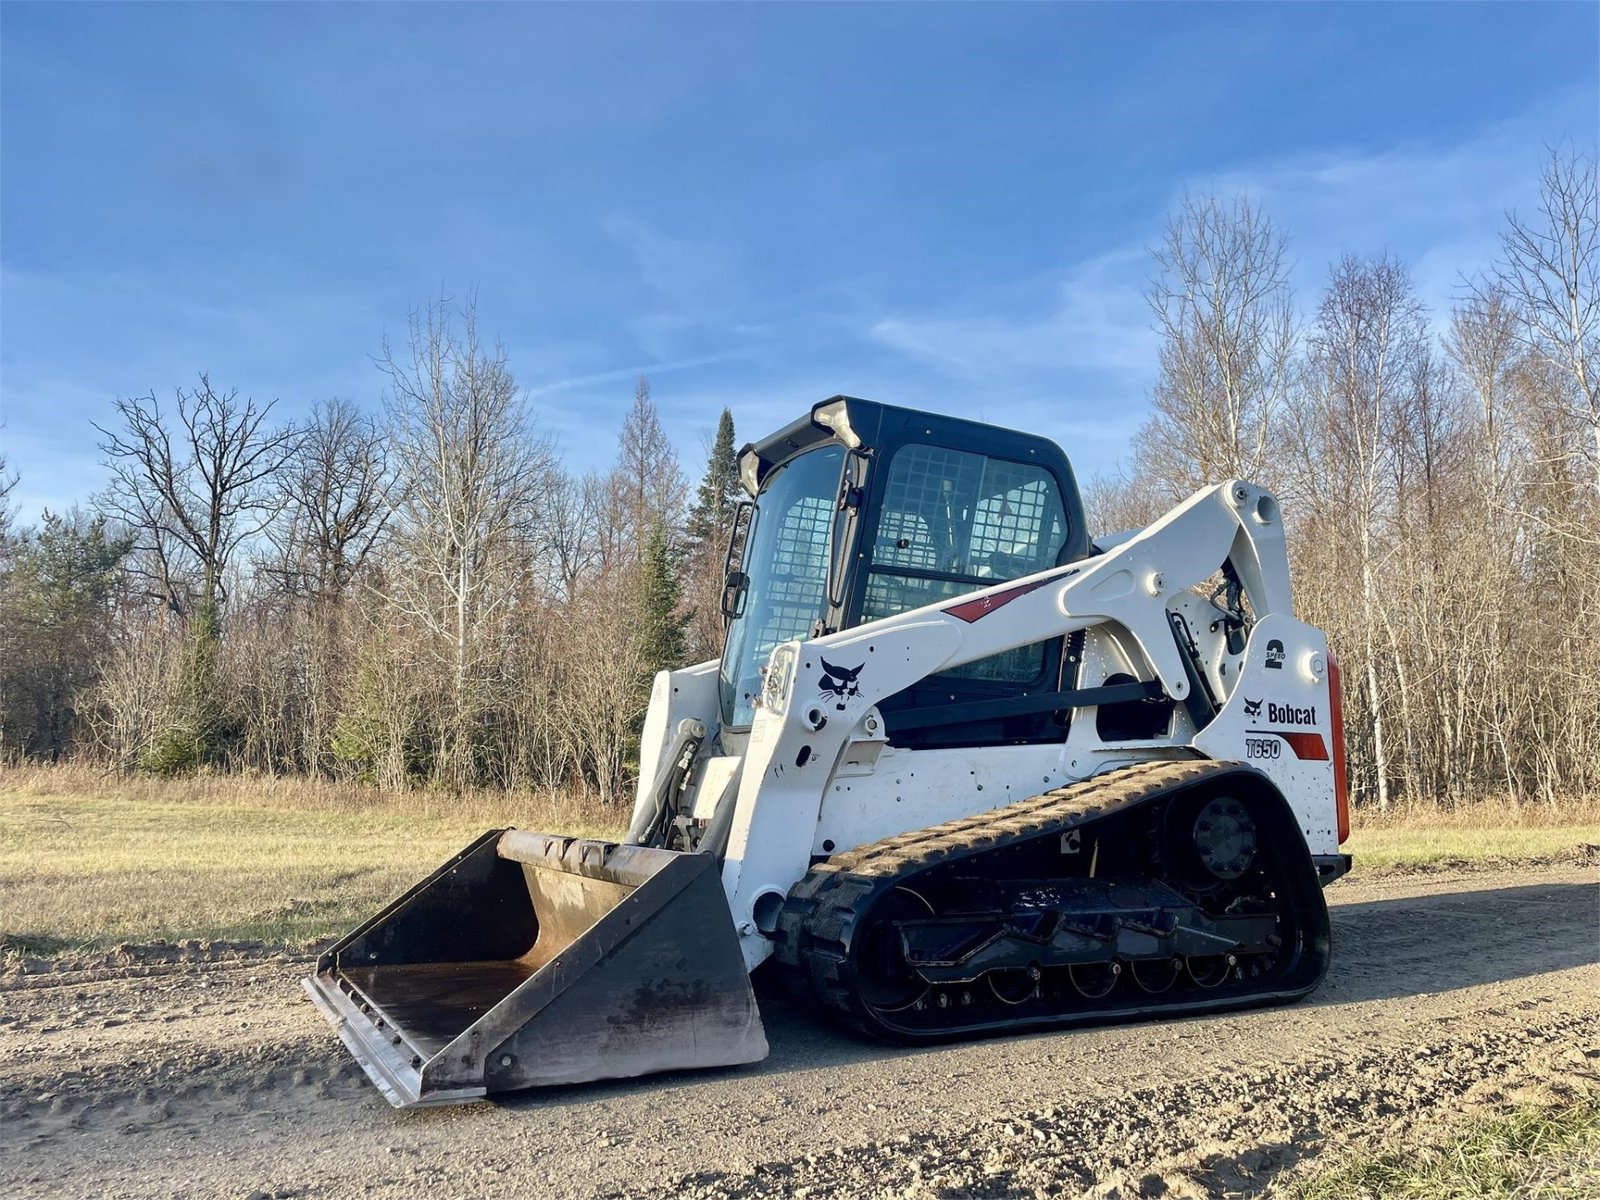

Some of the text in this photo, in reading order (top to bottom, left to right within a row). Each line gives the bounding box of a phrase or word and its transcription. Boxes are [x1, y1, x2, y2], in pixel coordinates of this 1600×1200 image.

[1265, 639, 1284, 669] 2
[1266, 651, 1286, 660] SPEED
[1268, 703, 1317, 725] Bobcat
[1246, 739, 1281, 759] T650
